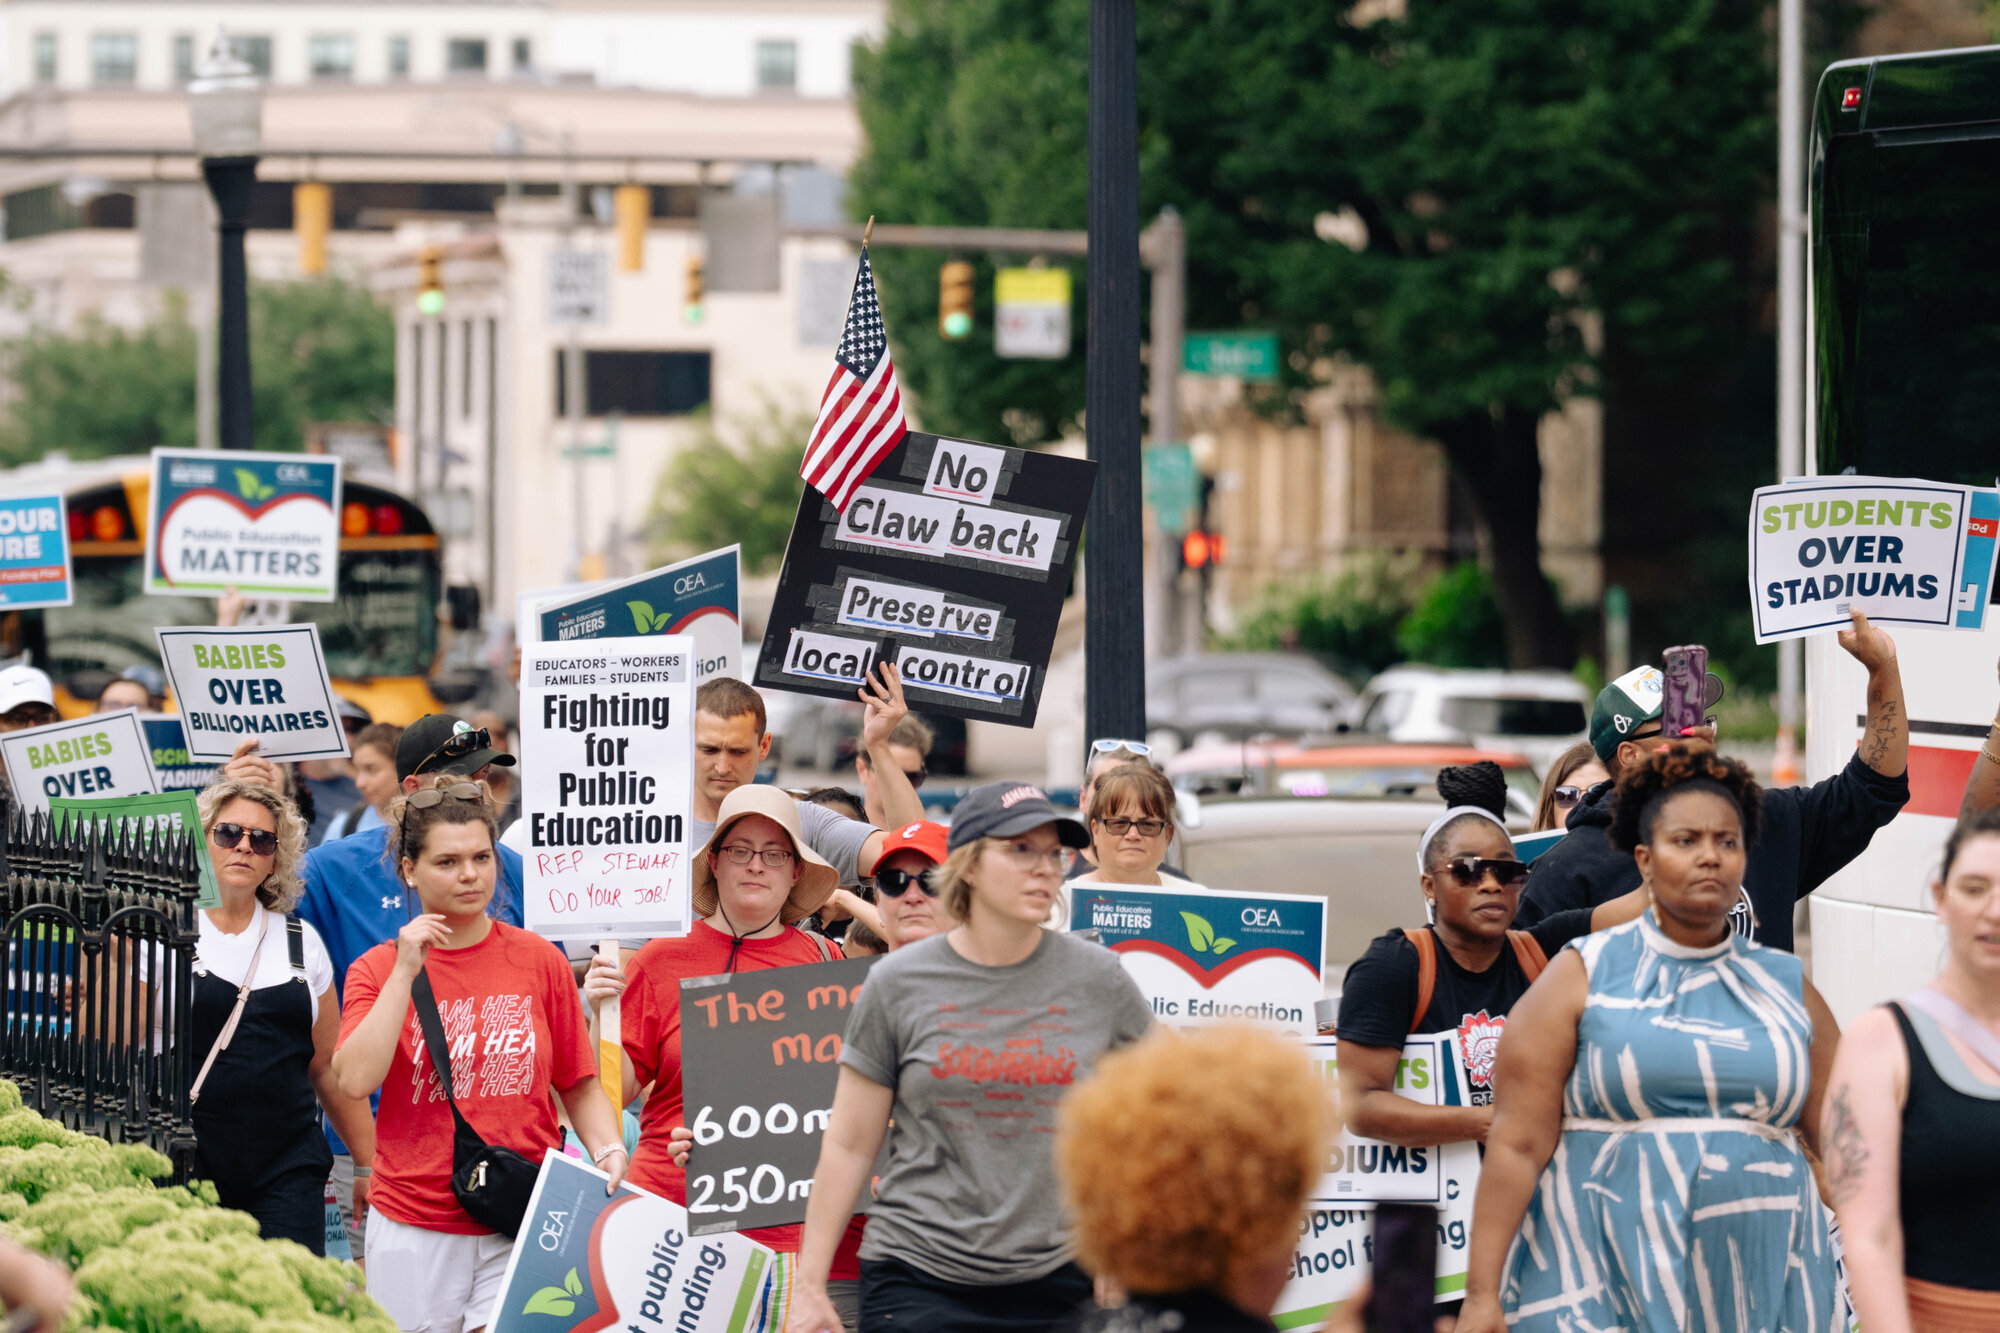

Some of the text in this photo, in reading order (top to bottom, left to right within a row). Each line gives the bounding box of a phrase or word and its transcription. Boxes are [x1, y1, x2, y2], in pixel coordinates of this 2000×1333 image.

[934, 451, 988, 492] No
[847, 497, 1039, 559] Claw back
[1762, 499, 1953, 534] STUDENTS
[182, 527, 322, 547] Public Education
[1798, 535, 1904, 568] OVER
[181, 547, 321, 577] MATTERS
[674, 572, 705, 595] OEA
[1767, 572, 1938, 609] STADIUMS
[847, 585, 992, 635] Preserve
[559, 616, 605, 641] MATTERS
[192, 643, 286, 670] BABIES
[535, 655, 680, 671] EDUCATORS WORKERS
[791, 636, 1027, 698] local control
[208, 677, 286, 706] OVER
[544, 671, 669, 686] FAMILIES STUDENTS
[189, 710, 329, 734] BILLIONAIRES
[543, 692, 670, 732] Fighting
[26, 731, 113, 770] BABIES
[585, 733, 629, 767] for
[42, 765, 115, 798] OVER
[158, 768, 216, 789] TADIUM
[559, 771, 656, 807] Public
[531, 810, 683, 847] Education
[537, 850, 680, 877] REP STEWART
[549, 878, 672, 913] DO YOUR JOB!
[1092, 904, 1152, 914] Public Education
[1092, 912, 1152, 929] MATTERS
[1241, 908, 1281, 927] OEA
[693, 989, 786, 1028] The
[1153, 997, 1303, 1022] lic Education
[447, 1032, 476, 1059] M
[483, 1030, 536, 1056] HEA
[481, 1072, 534, 1097] HEA
[1323, 1145, 1428, 1174] DIUMS
[538, 1211, 568, 1252] OEA
[639, 1228, 684, 1325] public
